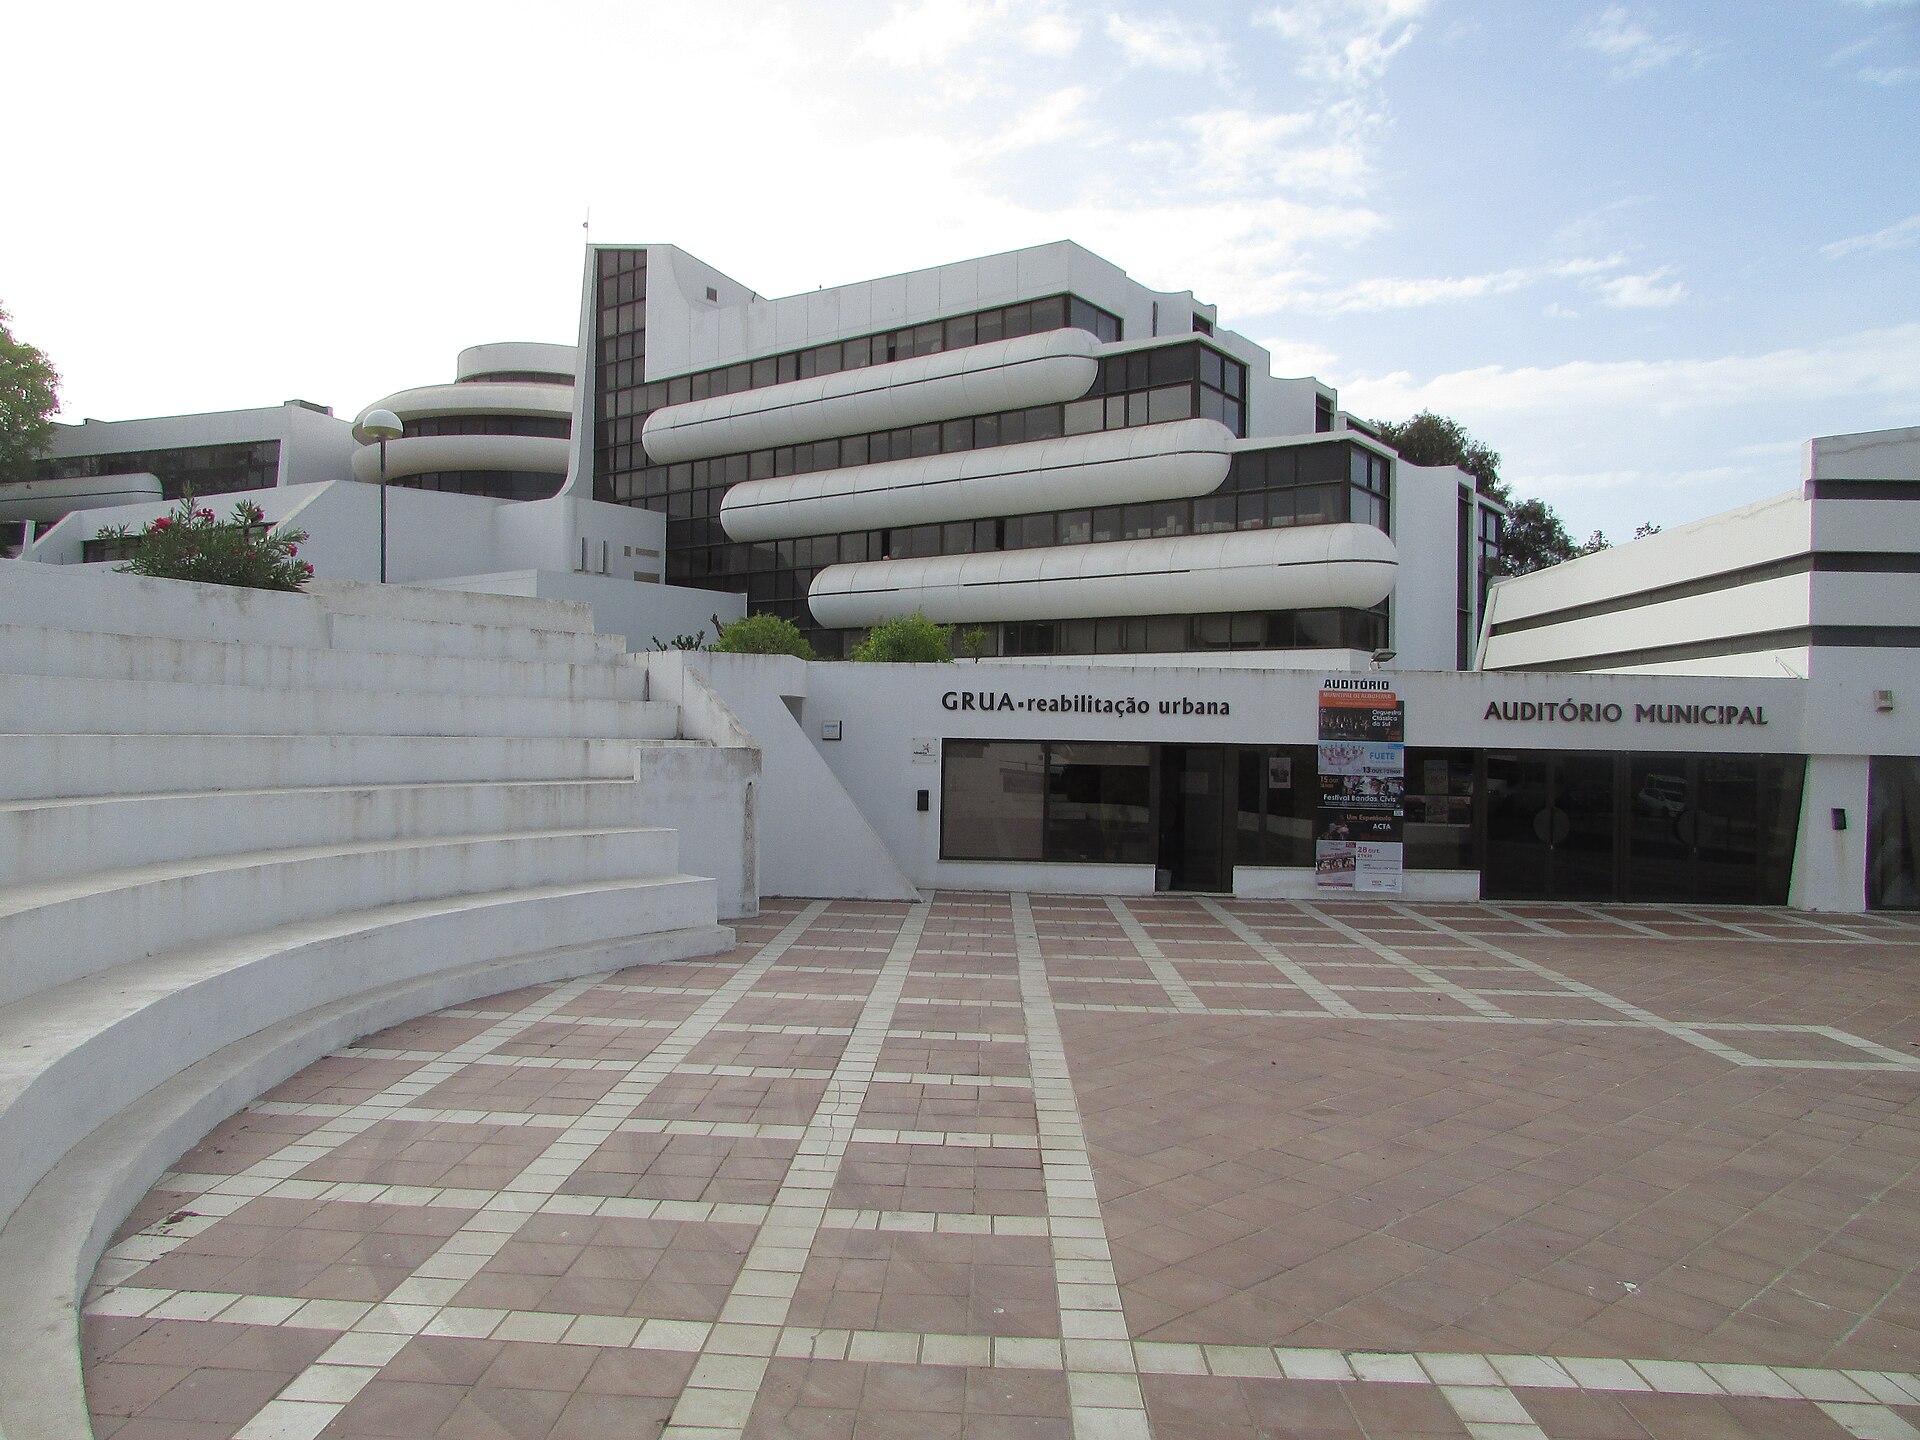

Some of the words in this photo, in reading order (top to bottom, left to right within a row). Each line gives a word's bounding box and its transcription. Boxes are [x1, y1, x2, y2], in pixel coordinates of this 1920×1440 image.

[1324, 679, 1389, 690] AUDITÓRIO
[1158, 697, 1230, 715] urbana
[1484, 698, 1622, 723] AUDITÓRIO
[1634, 703, 1768, 725] MUNICIPAL
[1370, 752, 1395, 760] FUETE
